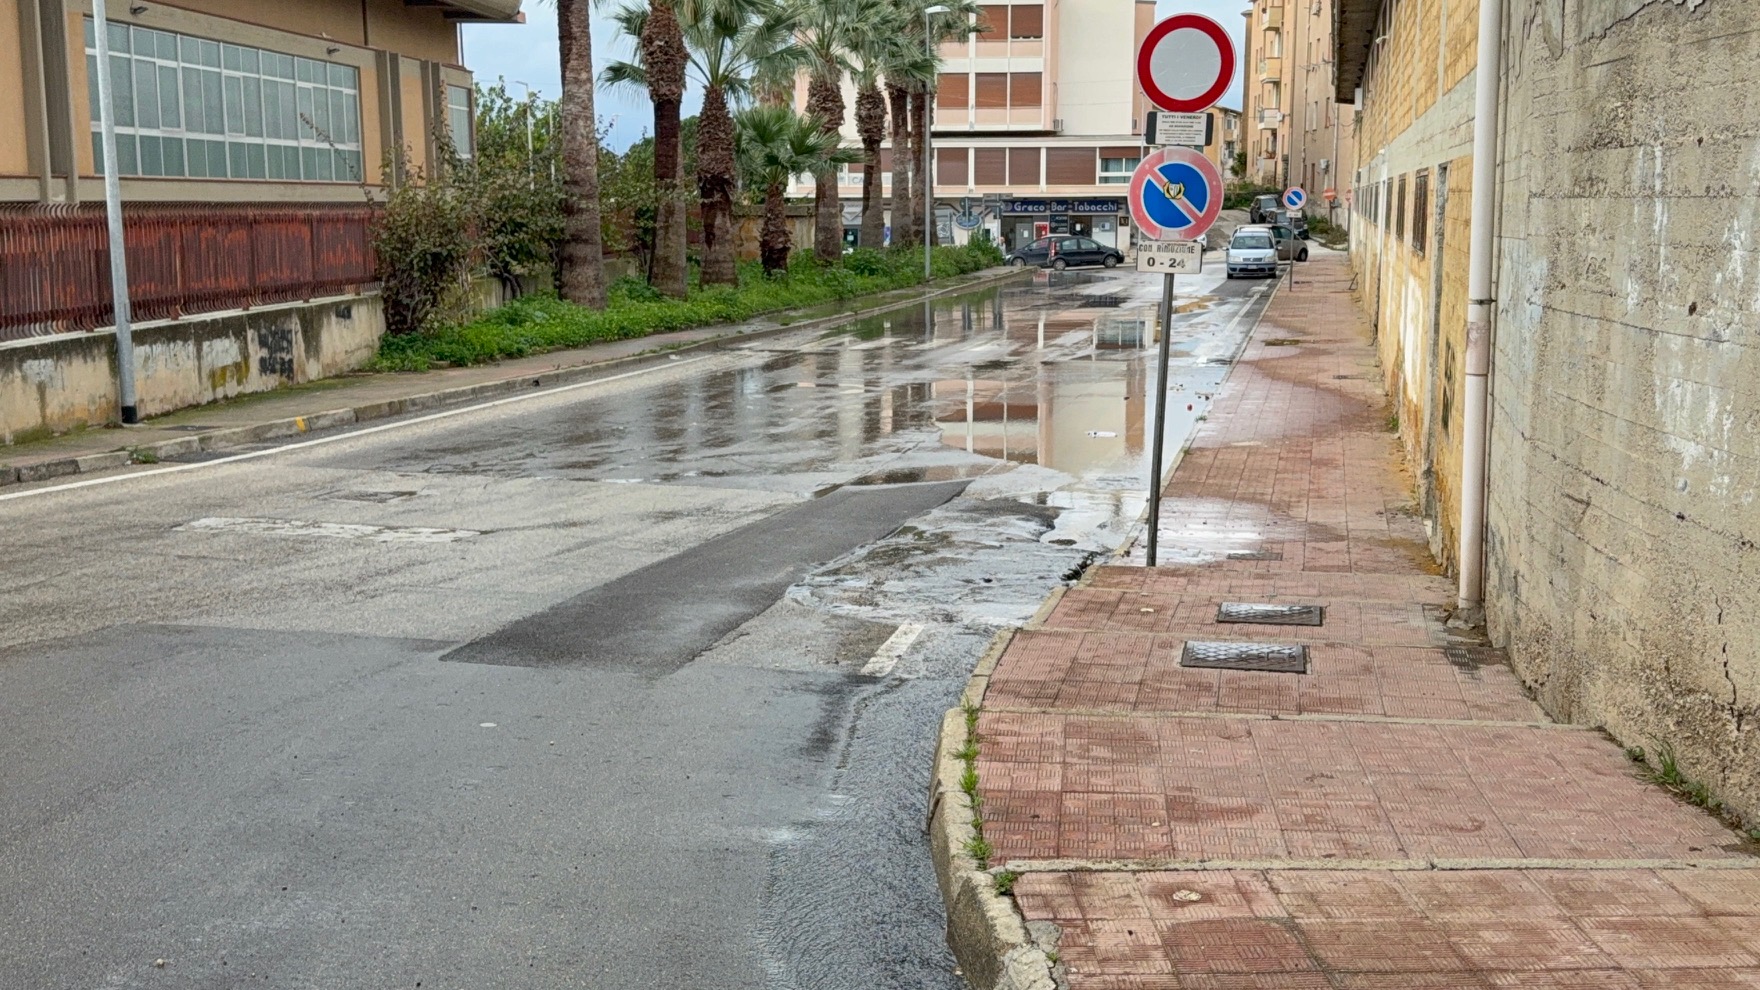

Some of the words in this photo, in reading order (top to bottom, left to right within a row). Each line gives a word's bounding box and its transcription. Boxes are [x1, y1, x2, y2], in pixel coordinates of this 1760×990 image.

[1014, 201, 1045, 212] Greco
[1051, 201, 1067, 212] Bar
[1073, 201, 1118, 212] Tabacchi
[1138, 244, 1153, 253] CON
[1146, 257, 1156, 268] 0
[1168, 258, 1186, 269] 24
